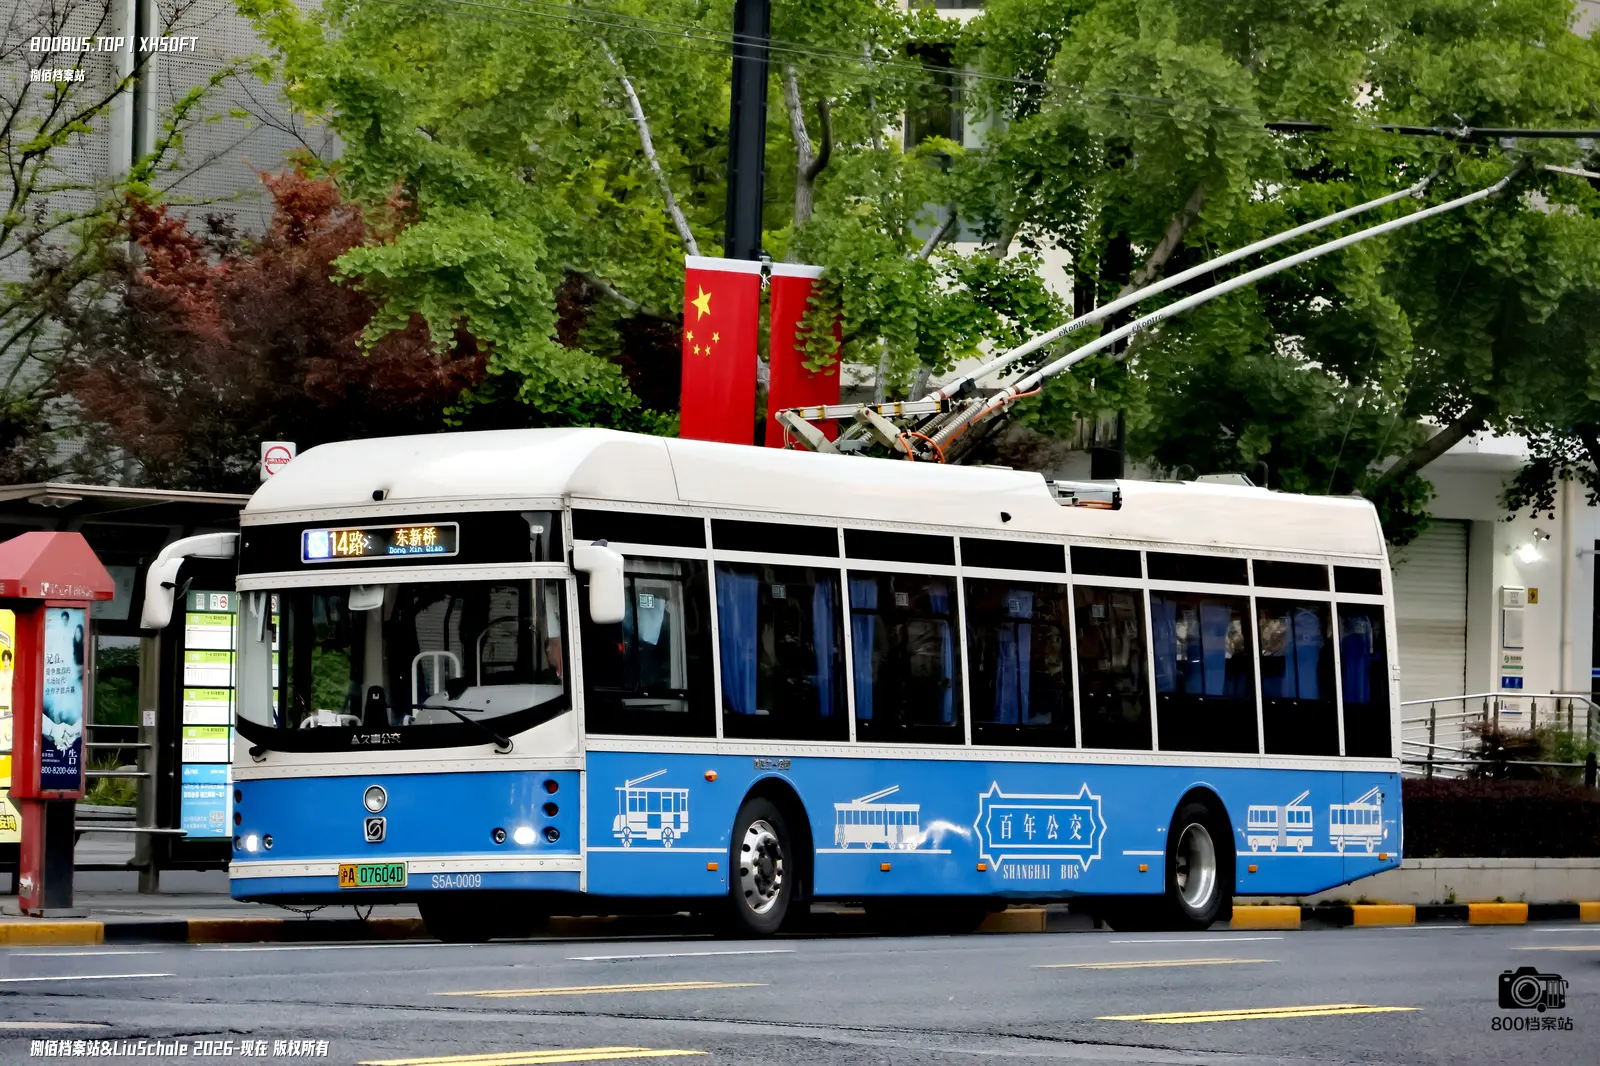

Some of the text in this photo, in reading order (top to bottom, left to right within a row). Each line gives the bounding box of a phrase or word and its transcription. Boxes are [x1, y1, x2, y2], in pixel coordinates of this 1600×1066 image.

[329, 530, 364, 556] 14路
[395, 526, 437, 547] 东新桥
[388, 544, 443, 554] Dong Xin Qiao
[999, 813, 1082, 840] 百年公交
[360, 866, 403, 883] 07604D
[1003, 864, 1079, 880] SHANGHAI BUS
[431, 873, 482, 889] S5A-0009
